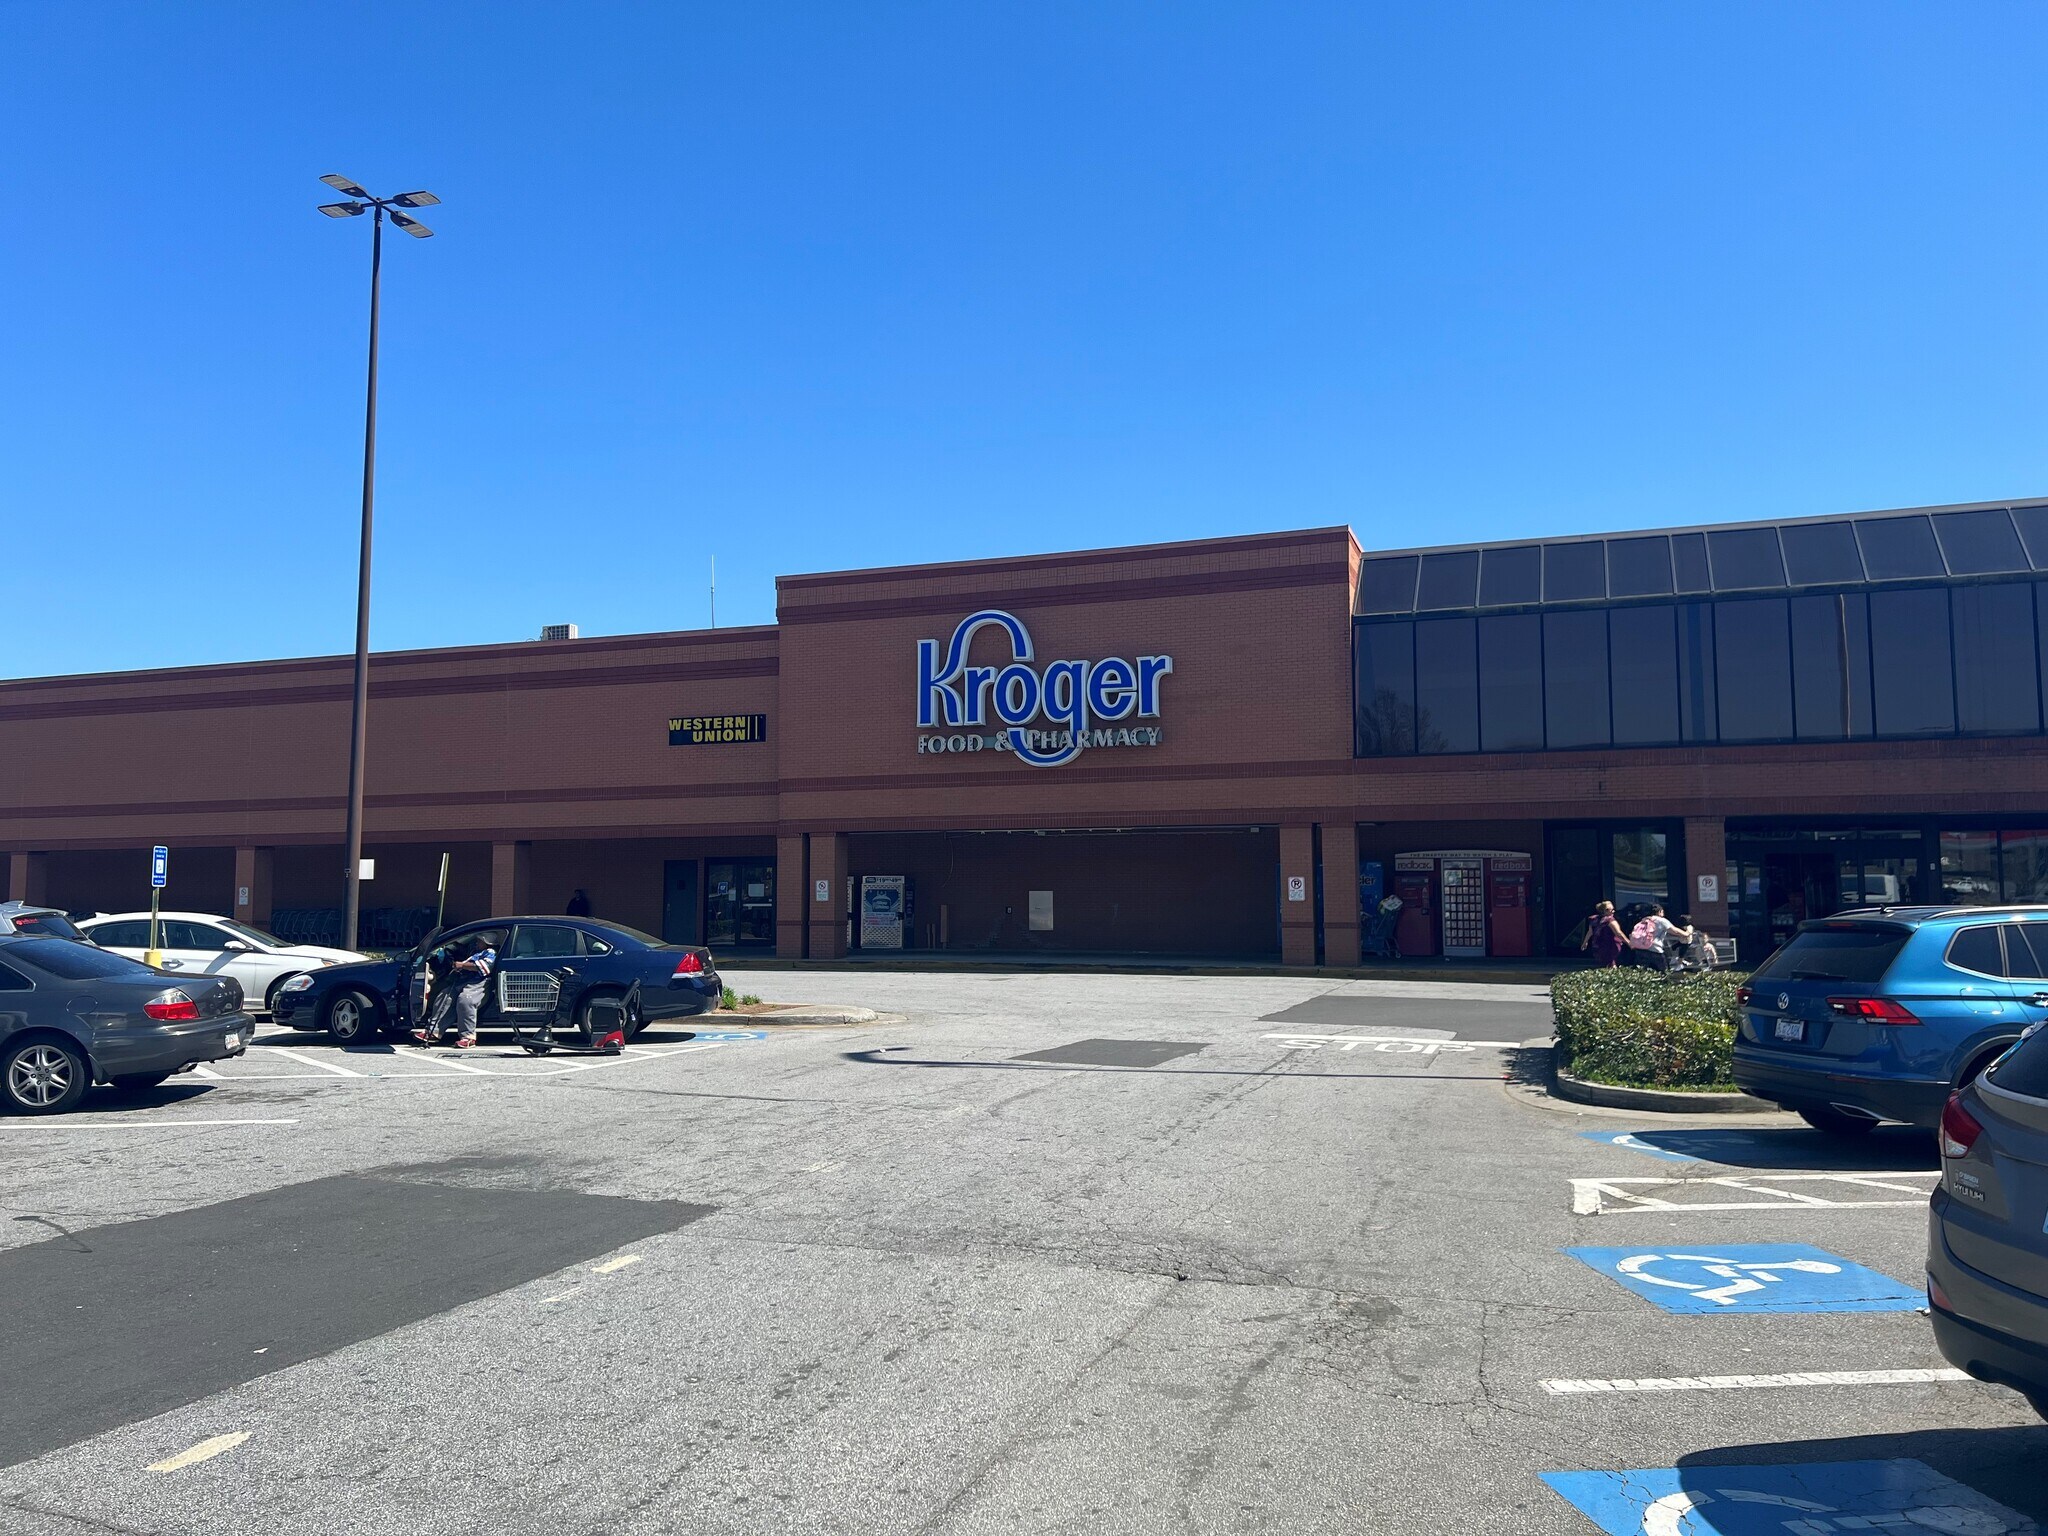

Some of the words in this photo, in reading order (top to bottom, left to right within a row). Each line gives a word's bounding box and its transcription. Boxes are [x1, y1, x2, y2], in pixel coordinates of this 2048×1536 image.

[916, 609, 1174, 768] Kroger
[668, 716, 746, 731] WESTERN
[692, 729, 746, 743] UNION
[917, 734, 984, 754] FOOD
[994, 730, 1016, 752] &
[1026, 726, 1161, 751] PHARMACY
[1494, 861, 1527, 870] redbox
[1277, 1039, 1476, 1055] STOP
